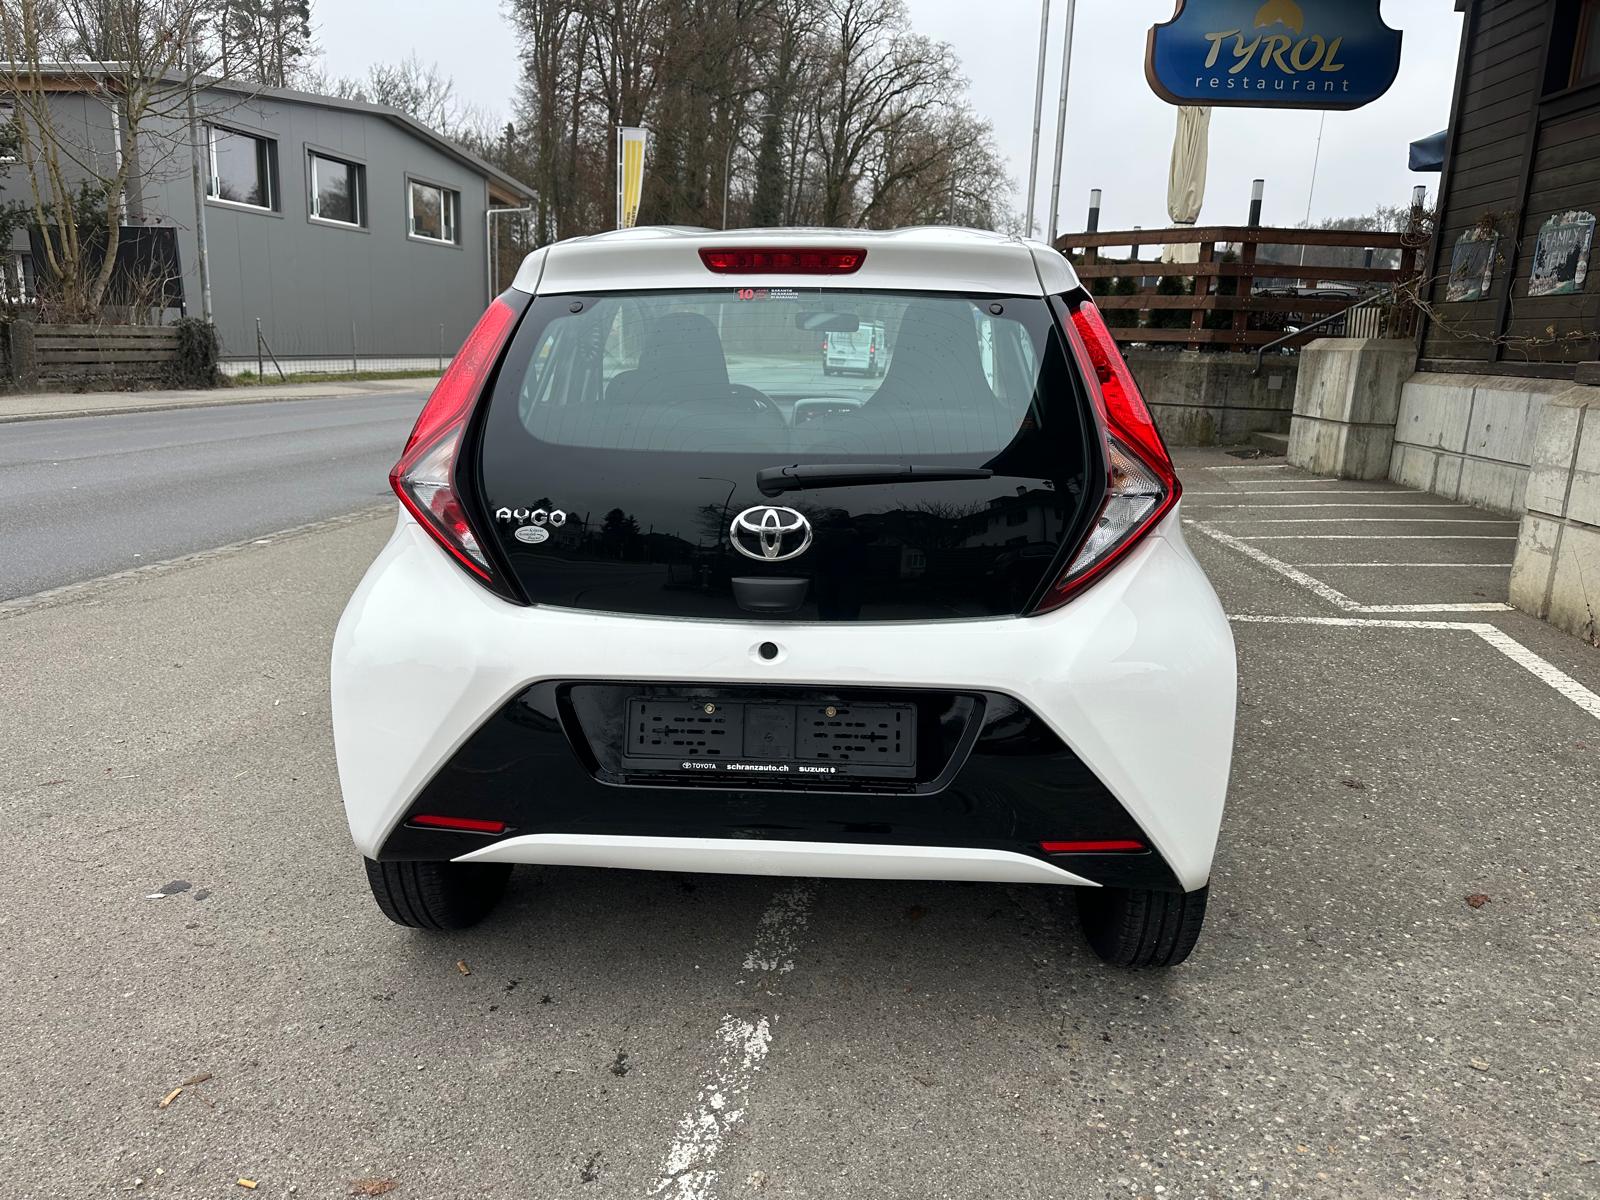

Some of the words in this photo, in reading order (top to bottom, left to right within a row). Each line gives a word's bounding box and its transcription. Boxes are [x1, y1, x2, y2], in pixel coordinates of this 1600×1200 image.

[1204, 28, 1345, 75] TYROL
[1195, 75, 1350, 92] restaurant
[737, 288, 754, 300] 10
[495, 506, 567, 528] AYGO
[726, 763, 790, 772] schranzauto.ch
